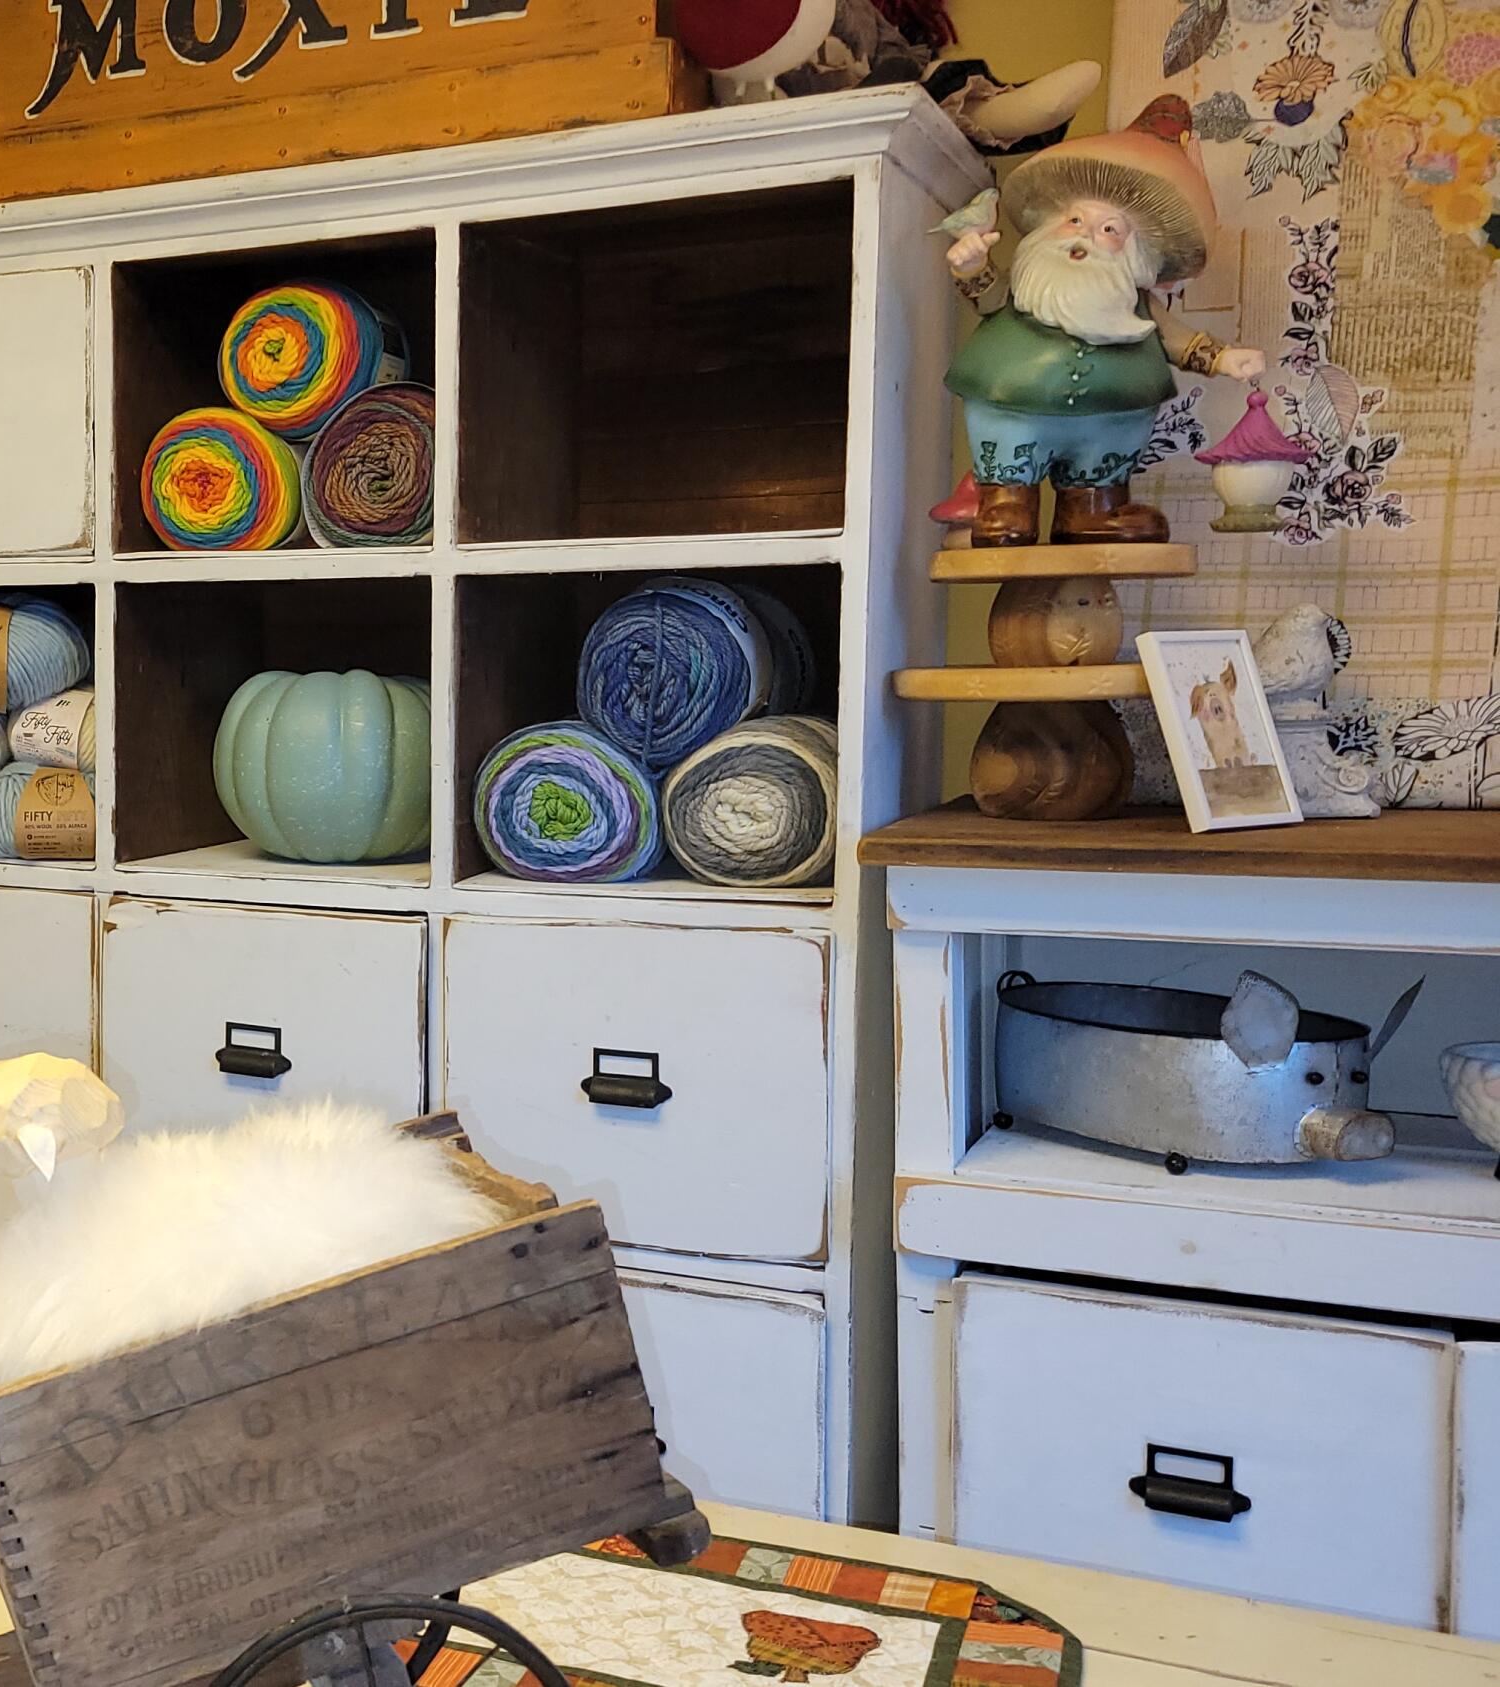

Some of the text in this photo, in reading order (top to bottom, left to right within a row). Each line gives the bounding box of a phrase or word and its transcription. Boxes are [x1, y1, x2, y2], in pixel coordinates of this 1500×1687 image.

[24, 0, 528, 120] MOX
[21, 711, 52, 730] Fifty
[44, 725, 73, 745] Fifty
[24, 811, 53, 822] FIFTY
